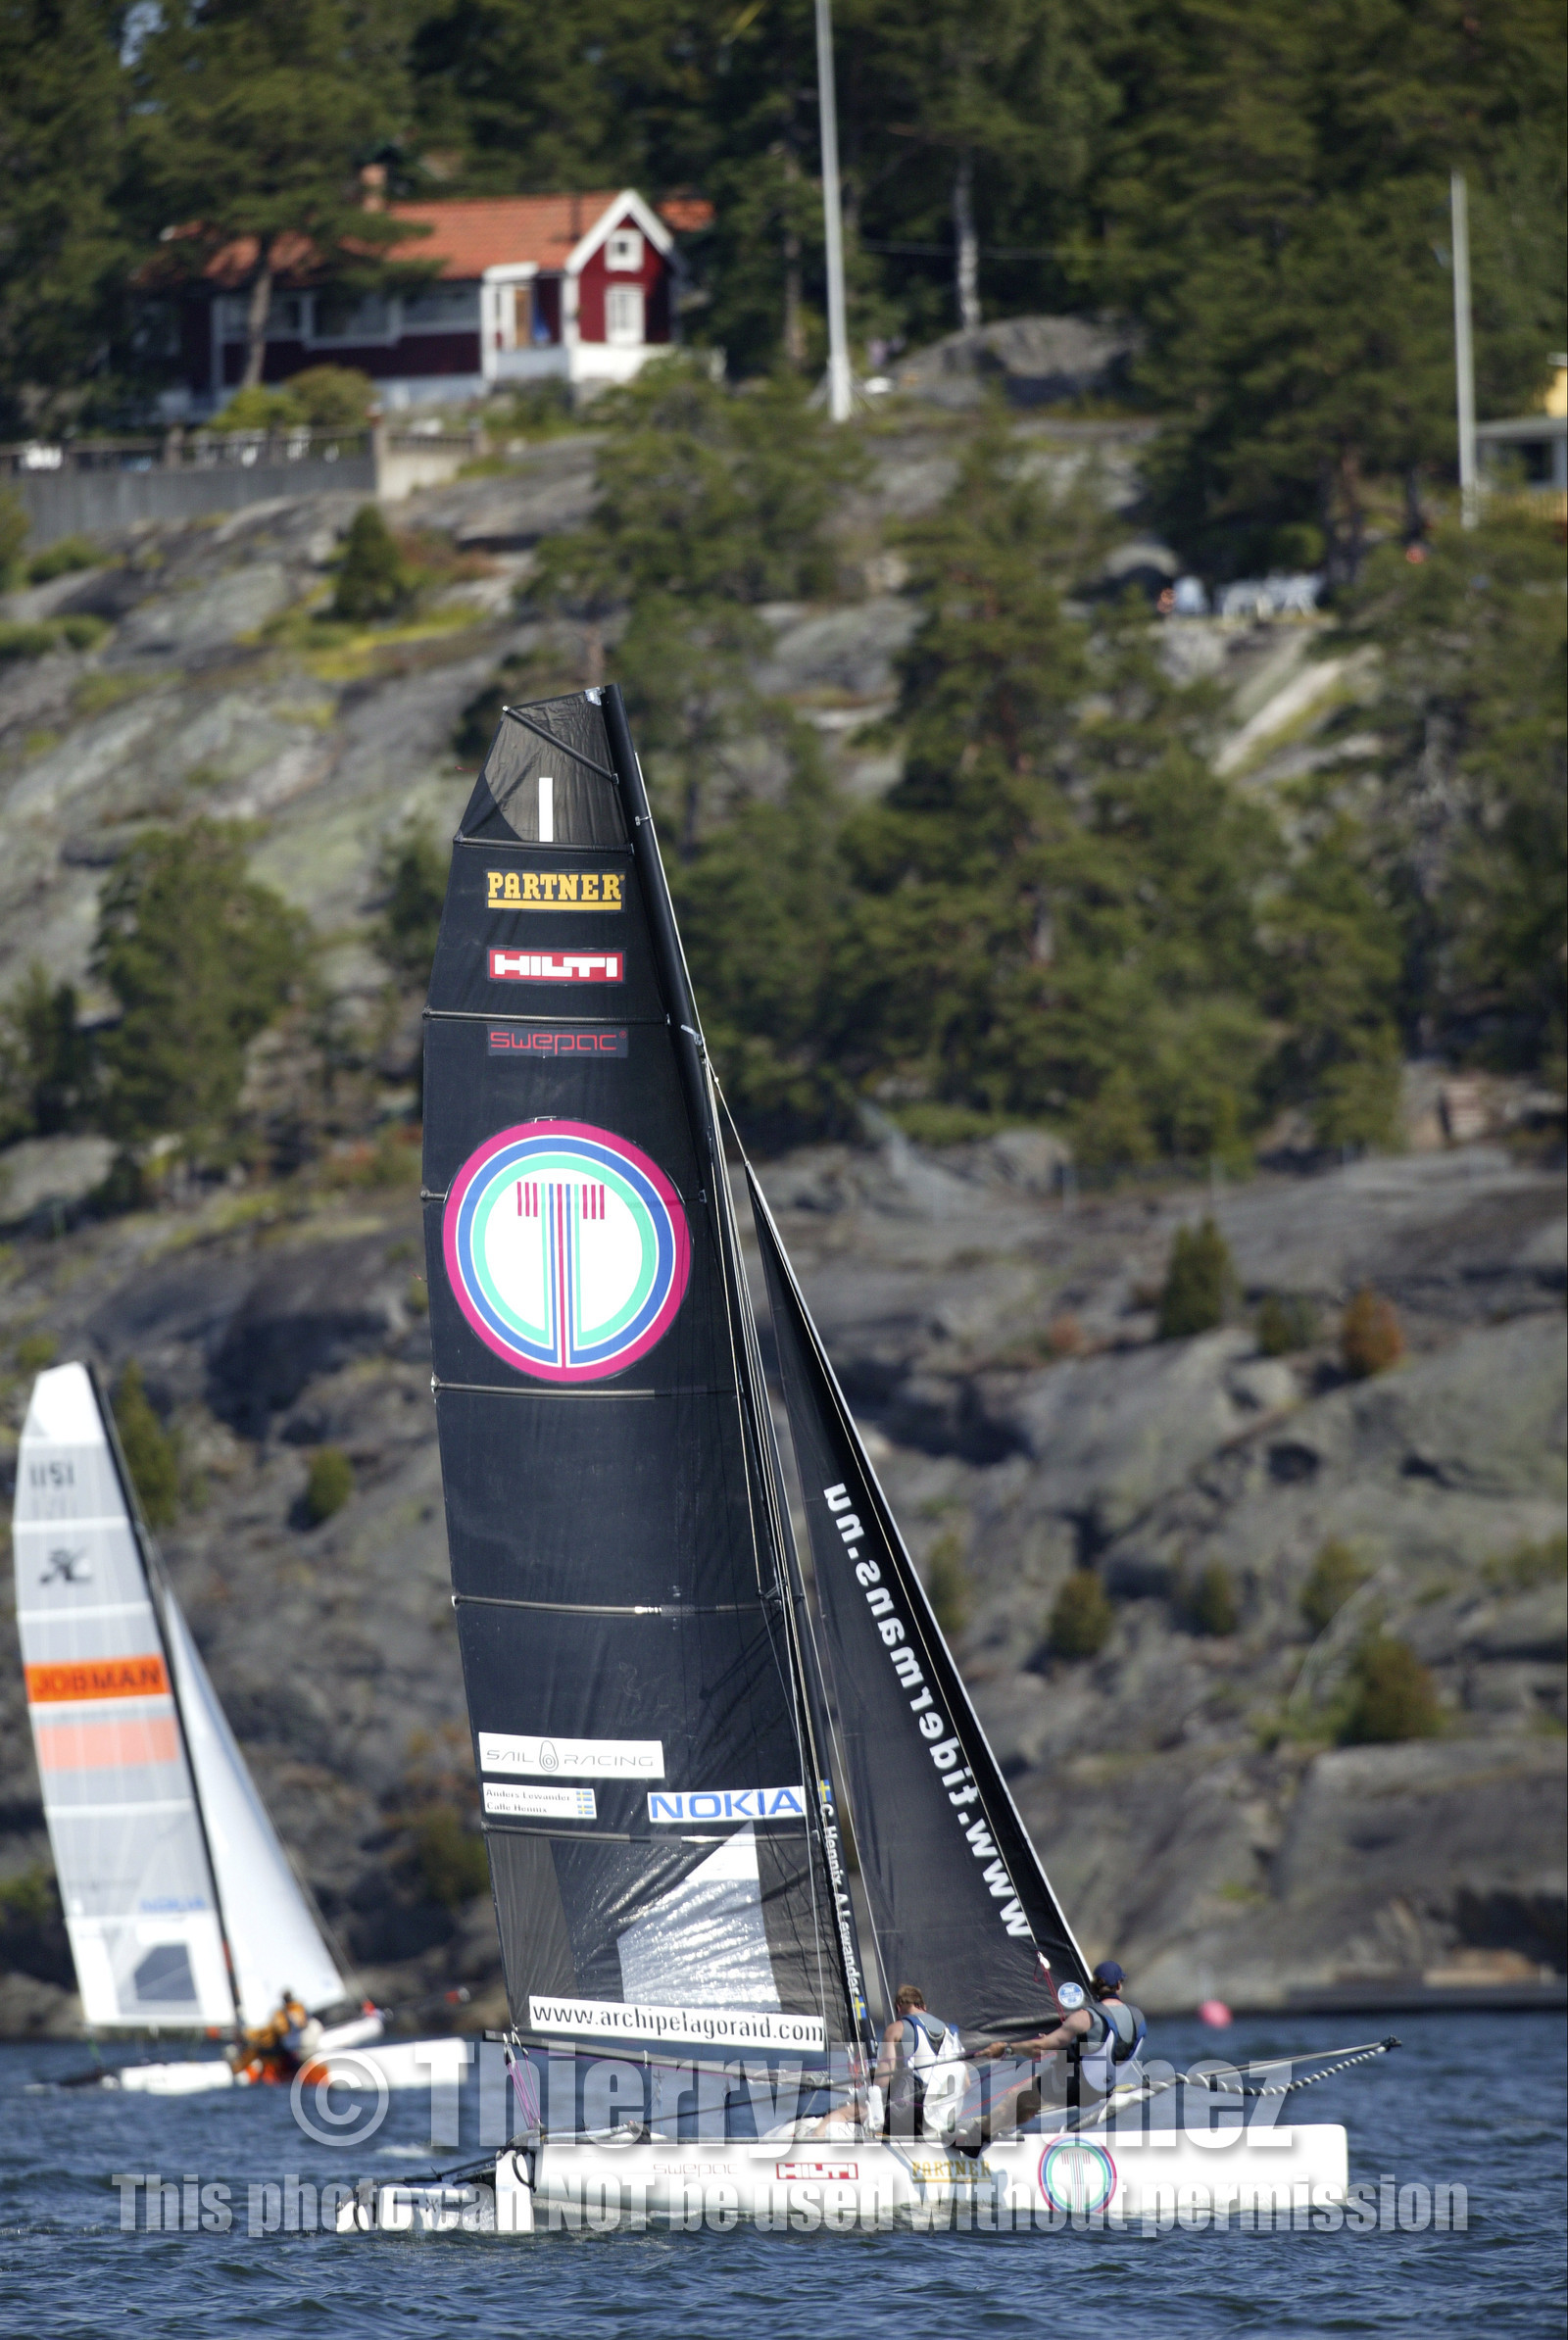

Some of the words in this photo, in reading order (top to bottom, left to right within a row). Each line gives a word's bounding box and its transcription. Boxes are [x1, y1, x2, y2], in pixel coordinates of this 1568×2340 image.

[487, 872, 622, 901] PARTNER
[494, 953, 618, 978] HILTI
[486, 1749, 535, 1763] SAIL
[564, 1754, 655, 1767] RACING
[650, 1787, 803, 1819] NOKIA
[532, 2004, 824, 2042] www.archipelagoraid.com
[778, 2164, 856, 2179] HILTI
[911, 2160, 992, 2177] PARTNER
